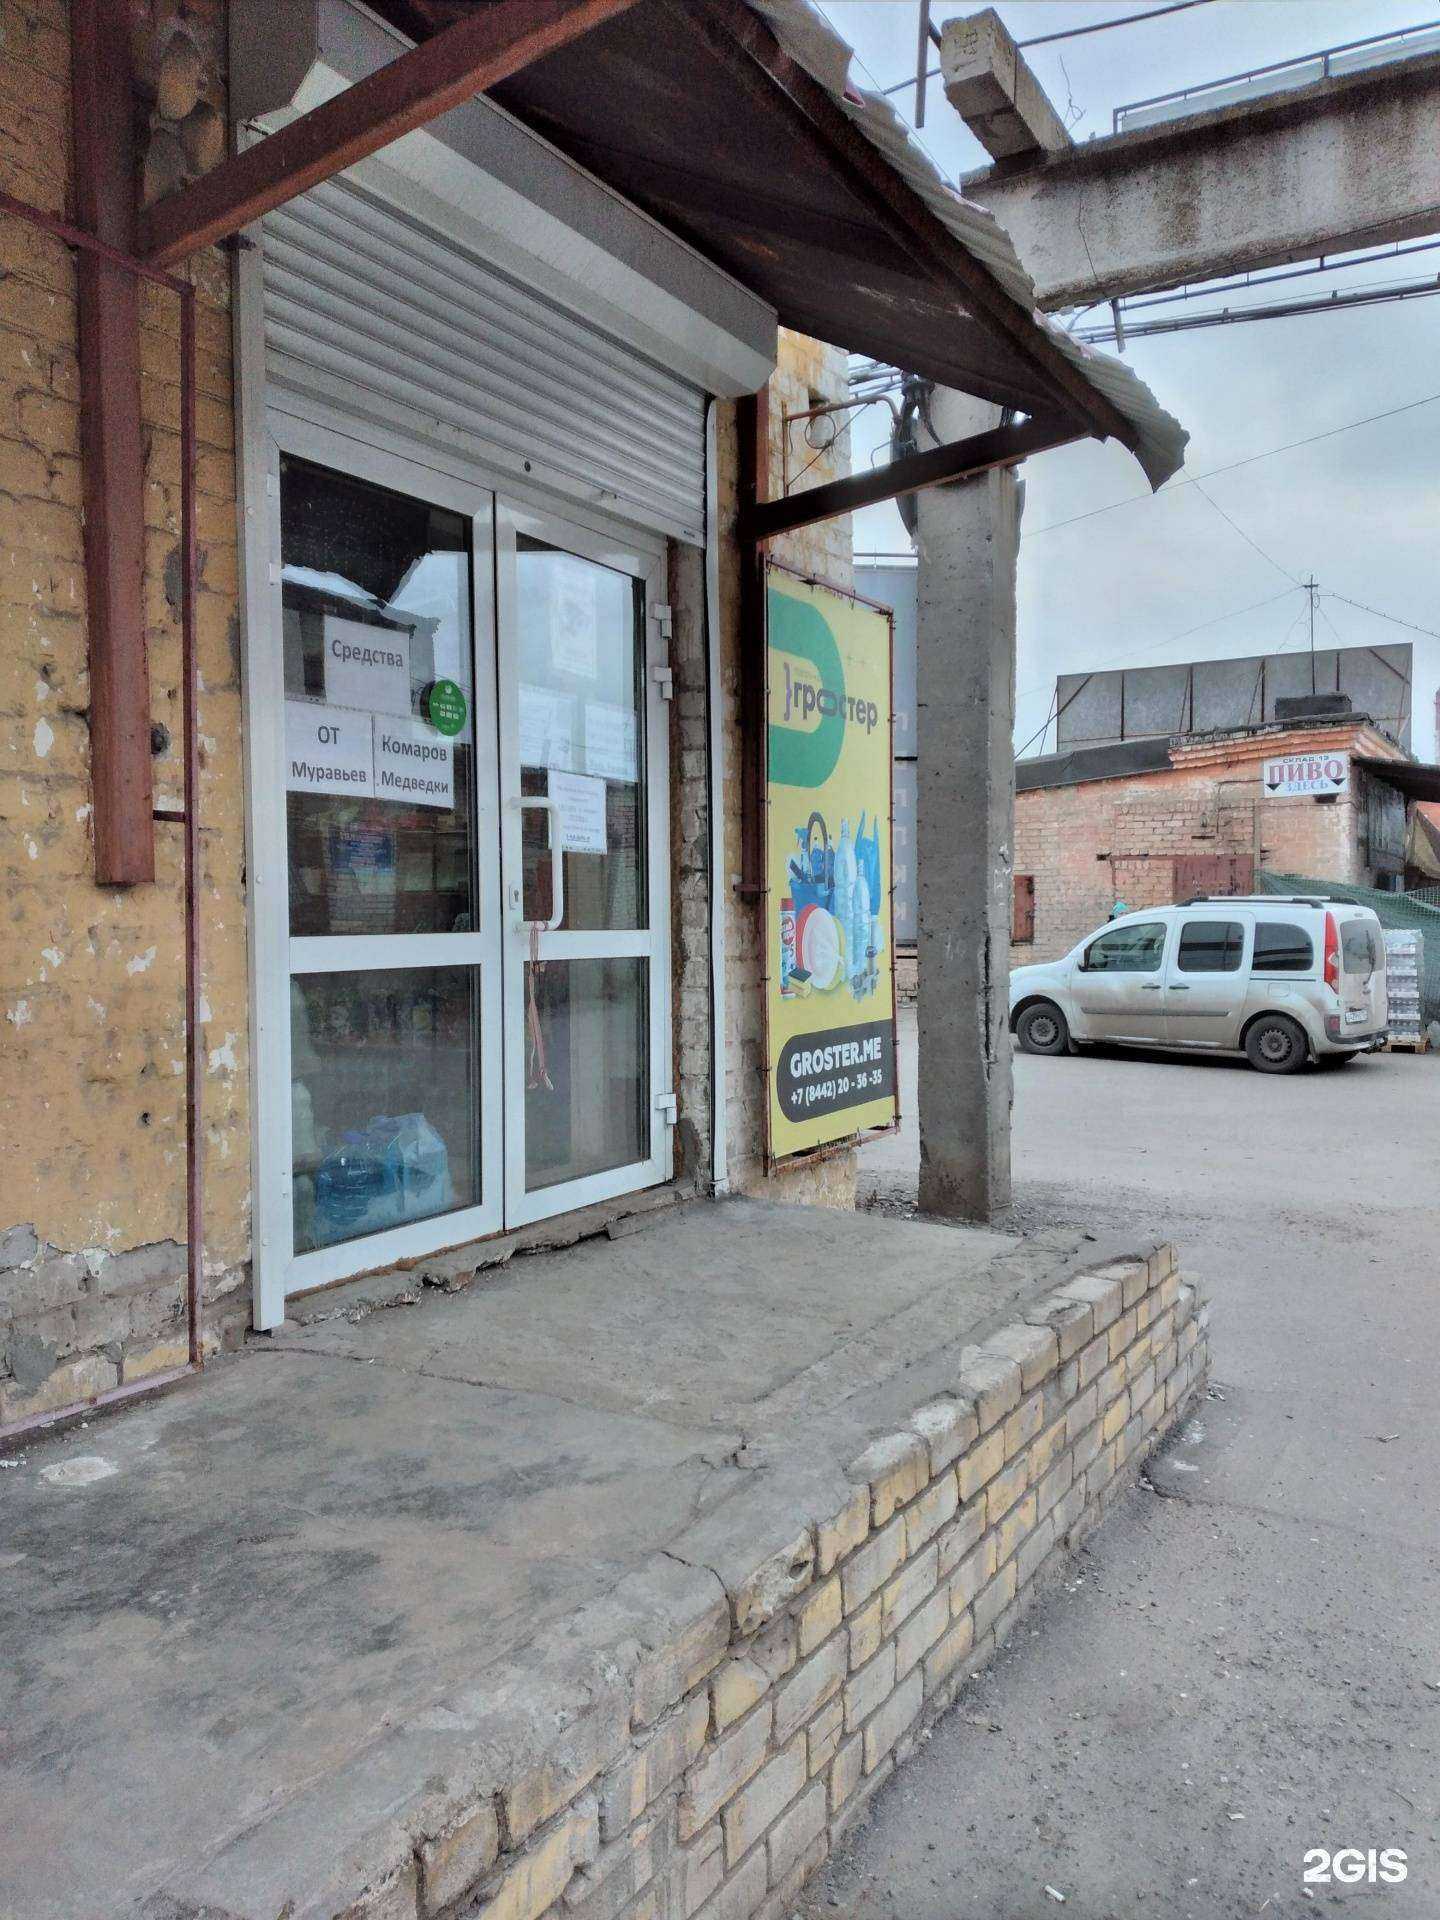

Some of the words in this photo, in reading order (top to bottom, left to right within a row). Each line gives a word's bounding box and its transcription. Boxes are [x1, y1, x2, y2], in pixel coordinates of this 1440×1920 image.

[331, 638, 404, 668] Средства
[382, 735, 447, 761] Комаров
[291, 760, 367, 784] Муравьев
[380, 770, 450, 795] Медведки
[1269, 760, 1344, 784] ПИВО
[1287, 780, 1328, 792] ЗДЕСЬ
[790, 1036, 882, 1078] GROSTER.ME
[790, 1087, 804, 1105] +7
[805, 1080, 837, 1107] (8442)
